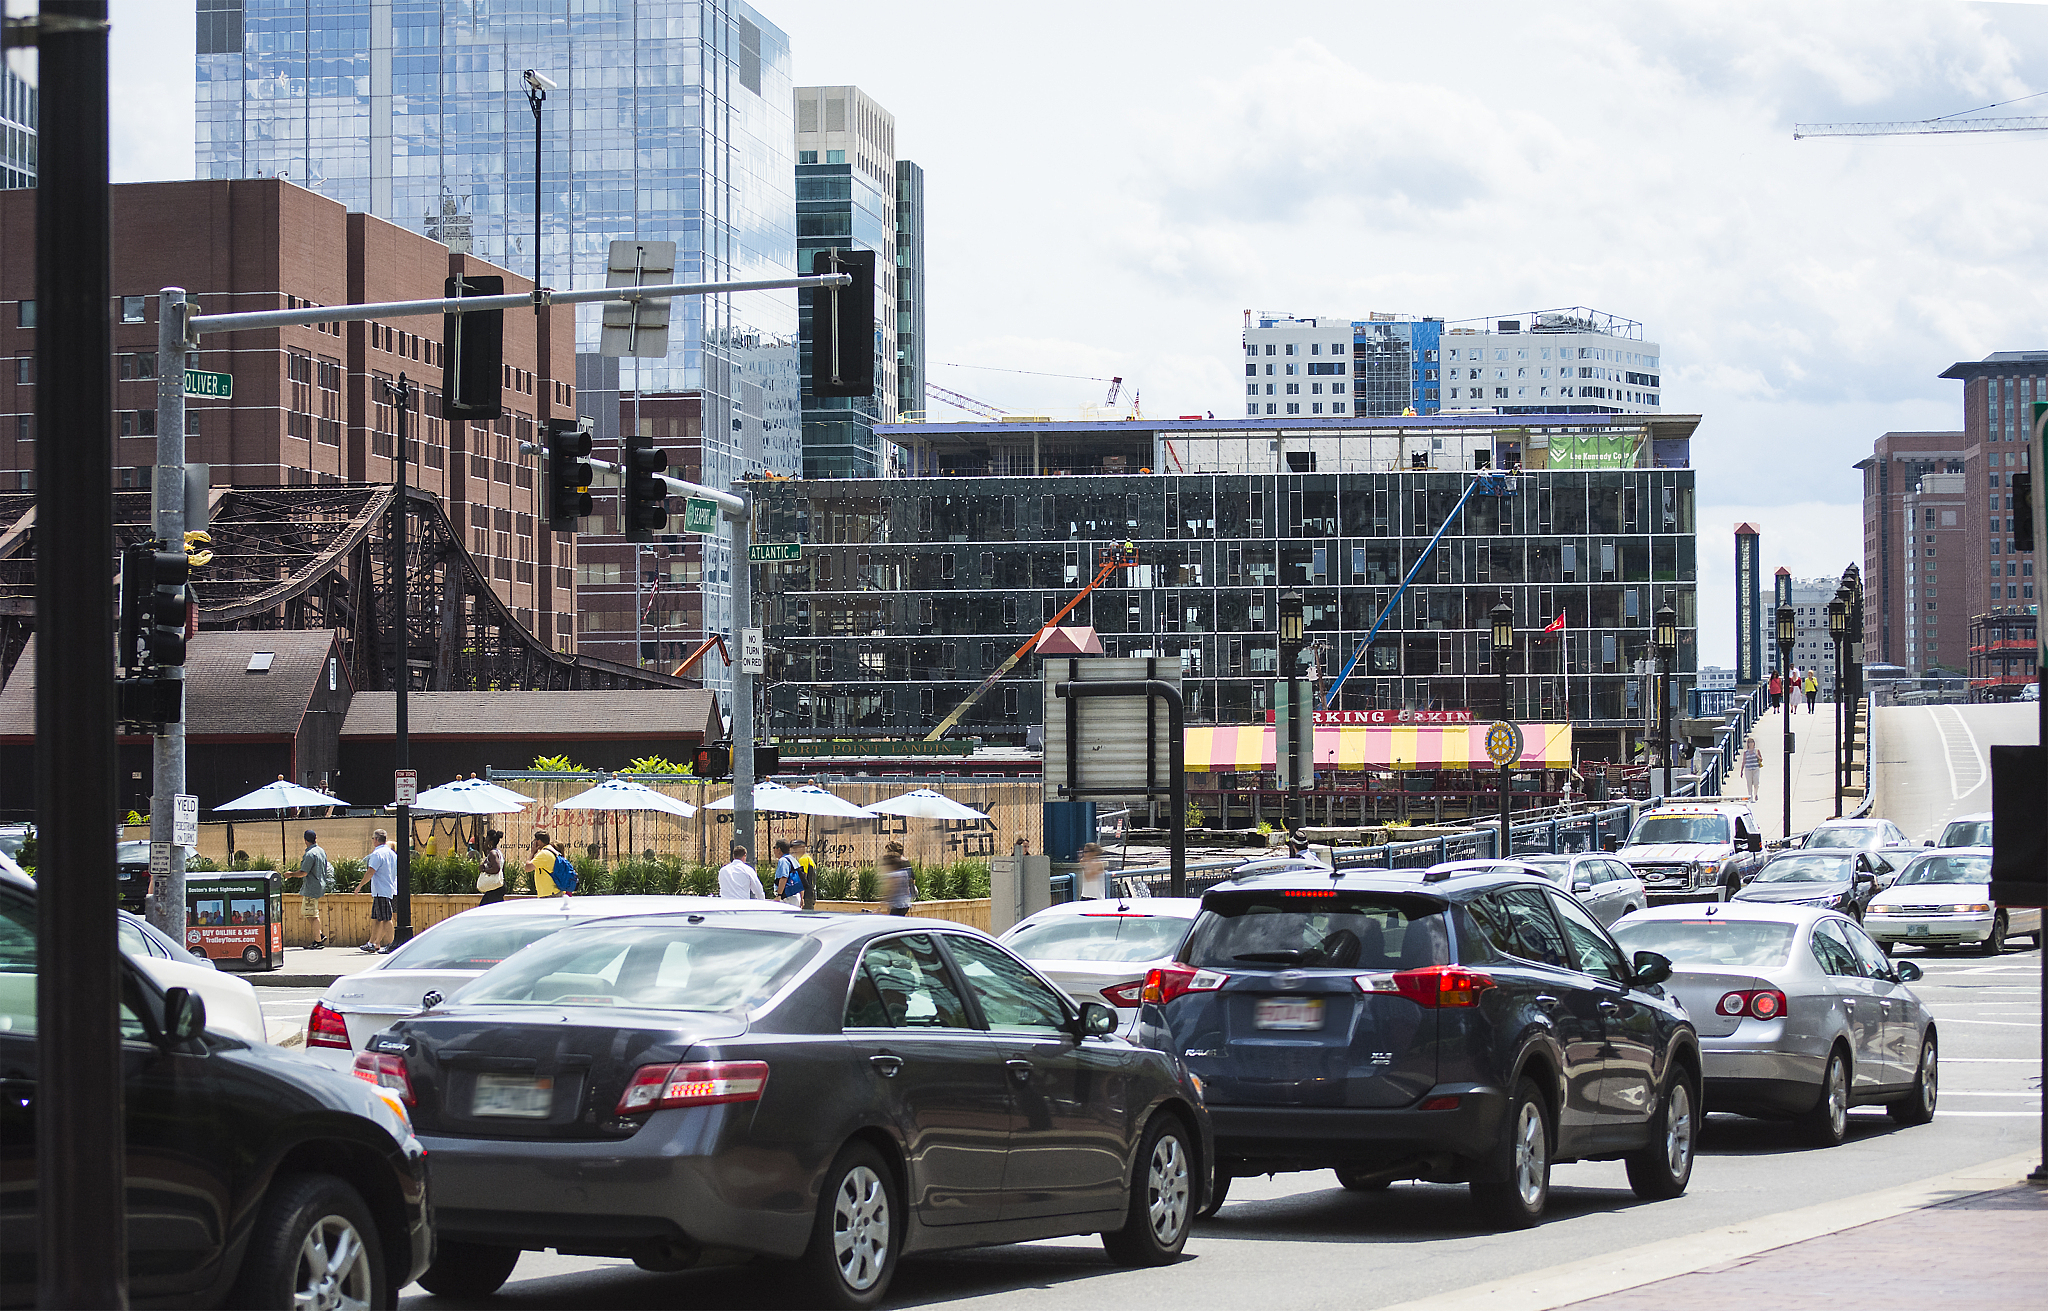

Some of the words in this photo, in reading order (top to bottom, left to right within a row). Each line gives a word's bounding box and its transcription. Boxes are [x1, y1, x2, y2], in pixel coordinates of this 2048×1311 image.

[185, 372, 218, 394] OLIVER
[222, 384, 228, 394] ST
[1570, 452, 1581, 460] Lee
[1583, 452, 1612, 462] Kennedy
[693, 507, 711, 526] SEAPORT
[750, 546, 789, 560] ATLANTIC
[791, 551, 799, 559] AVE
[748, 634, 757, 644] NO
[745, 645, 760, 655] TURN
[743, 657, 751, 667] ON
[751, 657, 763, 667] RED
[1312, 711, 1385, 723] RKING
[778, 744, 822, 755] FORT
[832, 743, 882, 754] POINT
[176, 799, 196, 812] YIELD
[716, 810, 800, 824] OYTERS
[202, 929, 214, 937] BUY
[243, 928, 259, 936] SAVE
[205, 936, 256, 944] TrolleyTours.com
